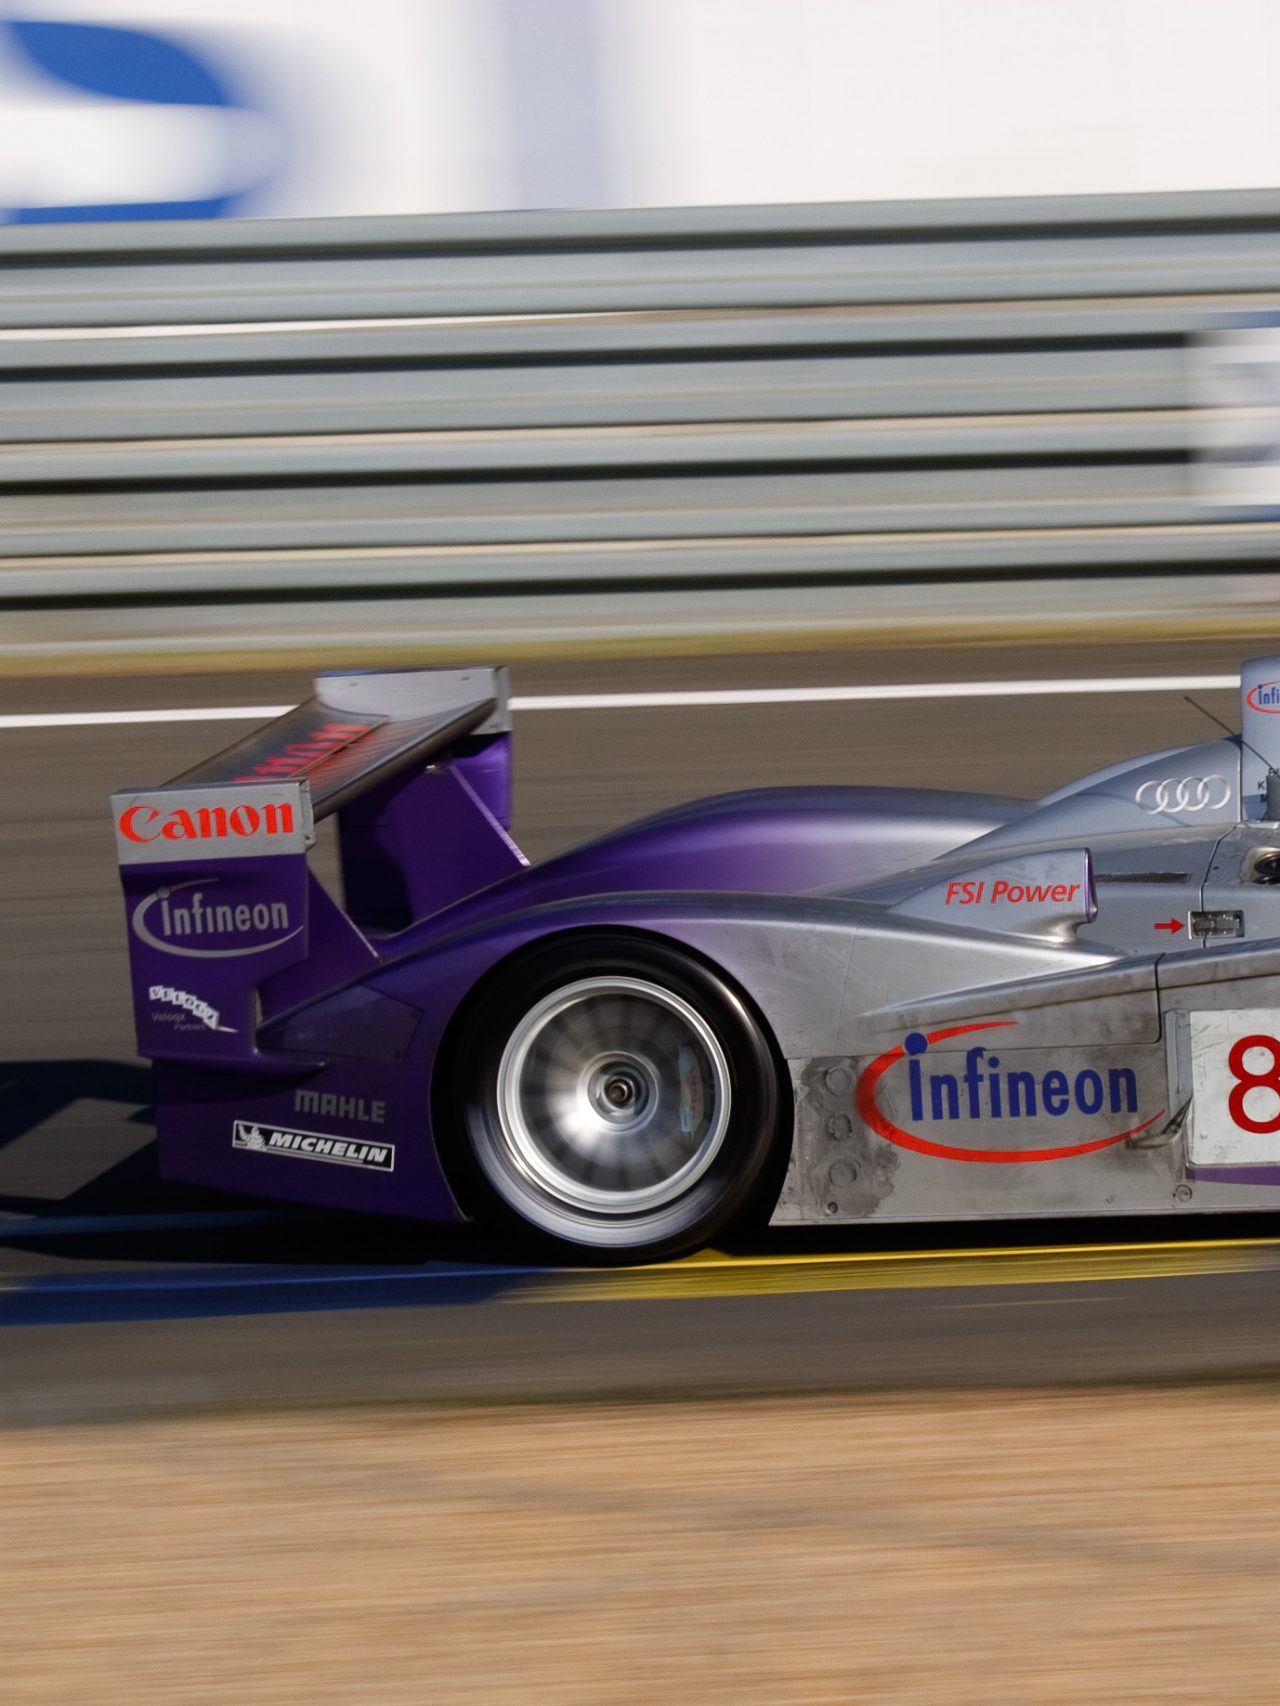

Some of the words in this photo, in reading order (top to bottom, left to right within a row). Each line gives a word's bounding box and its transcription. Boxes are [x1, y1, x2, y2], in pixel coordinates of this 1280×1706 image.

[119, 802, 294, 843] Canon
[945, 881, 985, 905] FSI
[991, 880, 1081, 904] Power
[294, 1088, 386, 1123] MAHLE
[269, 1131, 388, 1163] MICHELIN
